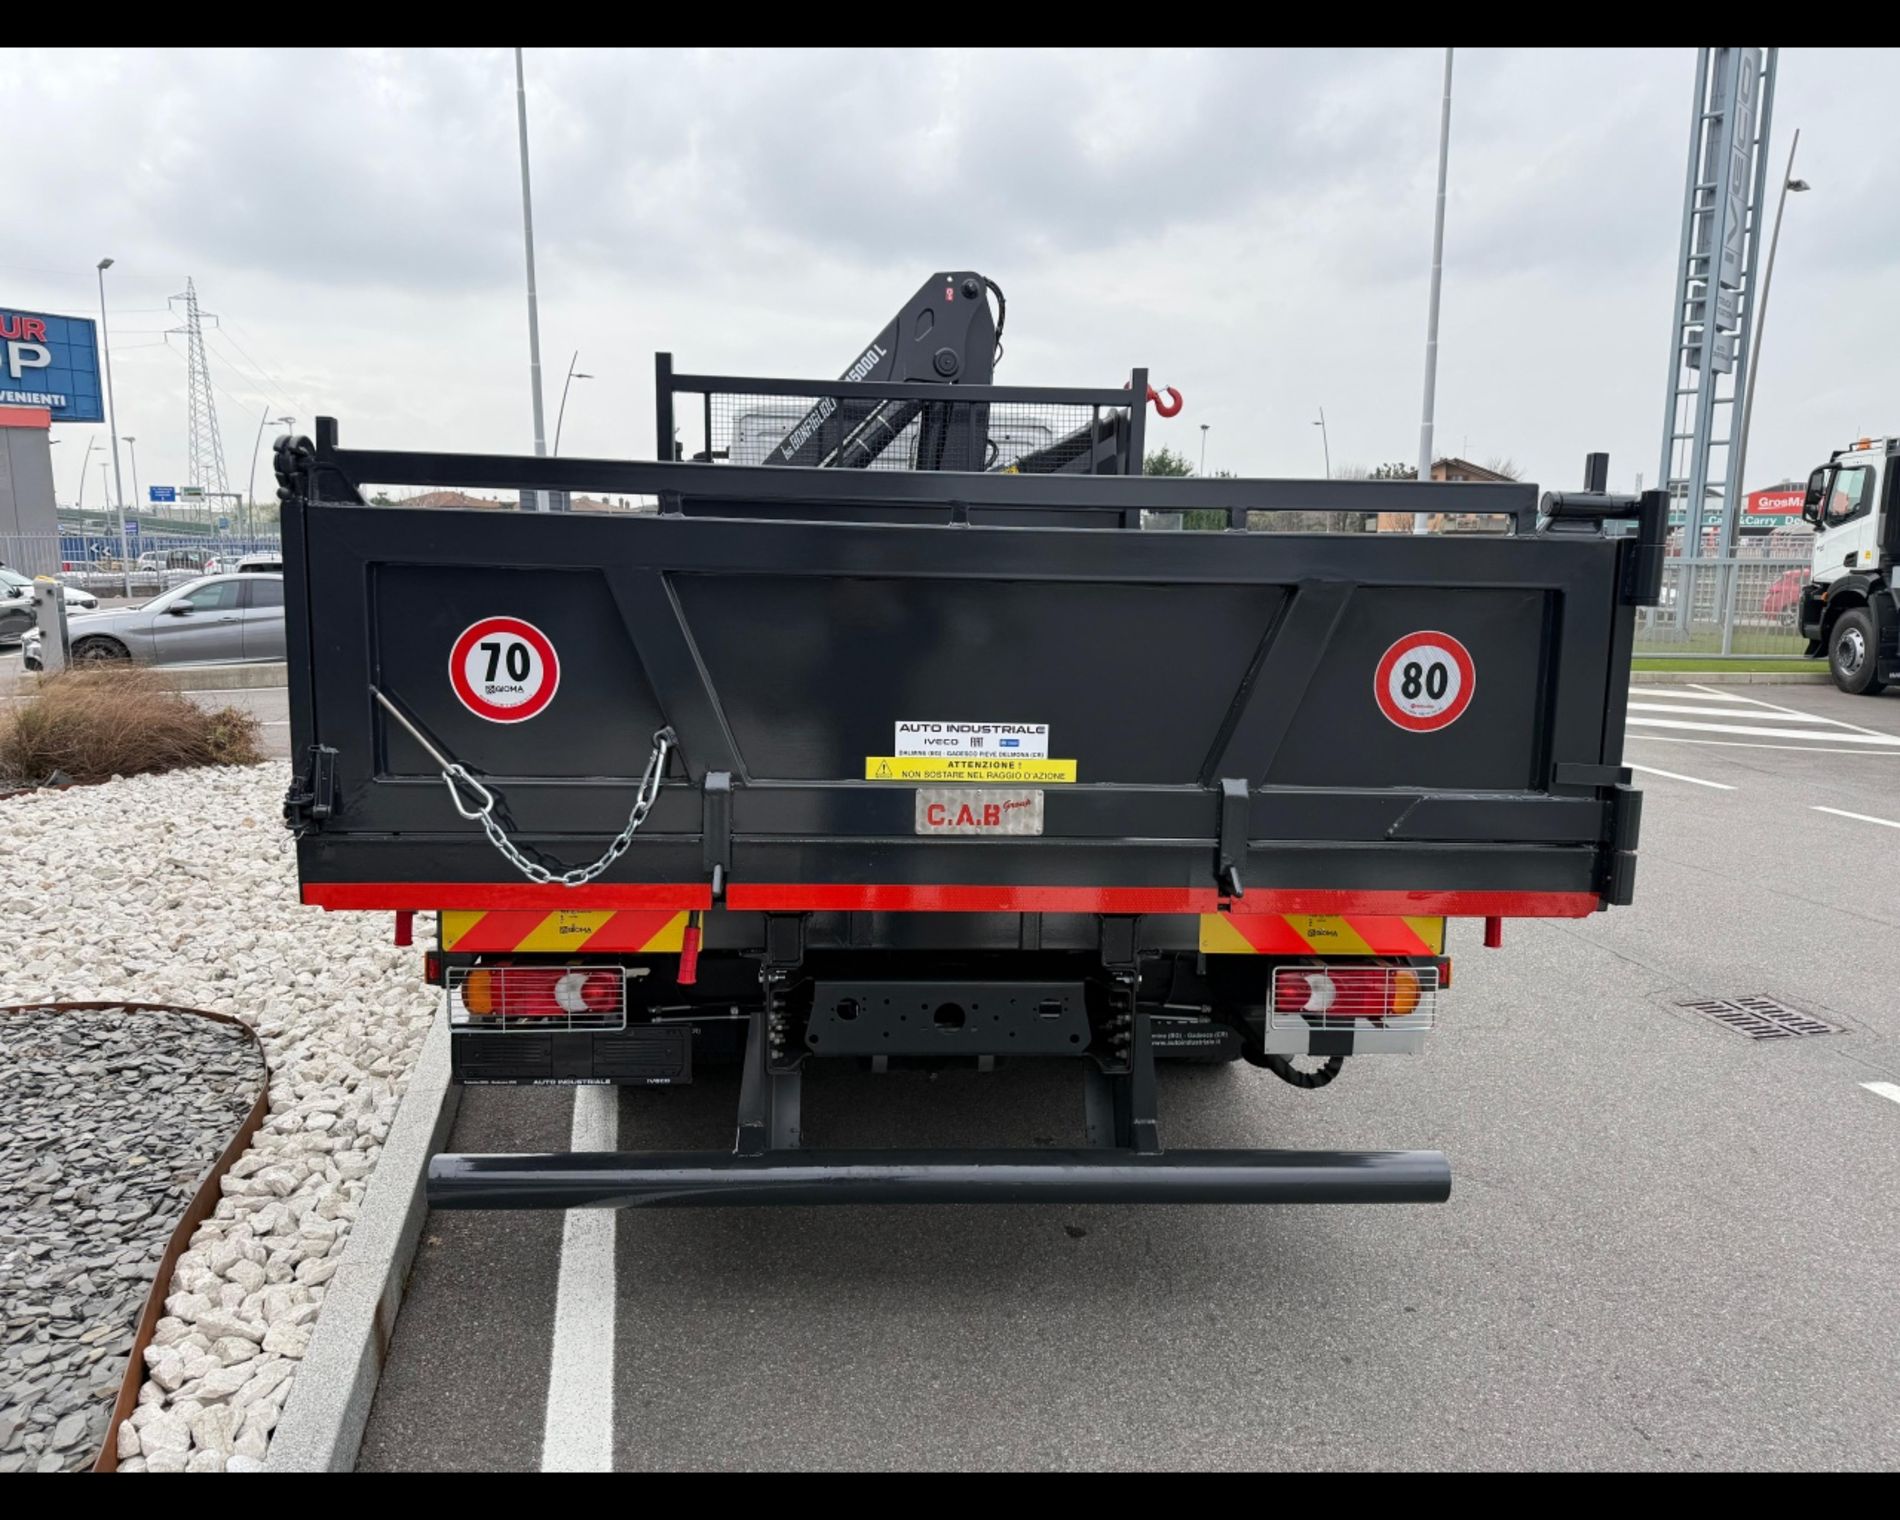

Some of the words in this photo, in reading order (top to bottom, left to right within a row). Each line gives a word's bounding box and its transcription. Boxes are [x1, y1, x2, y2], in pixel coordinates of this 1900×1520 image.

[1724, 55, 1752, 265] IVECO
[0, 341, 51, 378] P
[480, 642, 531, 682] 70
[1401, 661, 1448, 700] 80
[899, 723, 942, 733] AUTO
[946, 724, 1046, 734] INDUSTRIALE
[924, 738, 959, 746] IVECO
[970, 737, 984, 748] FIAT
[902, 770, 921, 779] NON
[924, 771, 964, 779] SOSTARE
[967, 771, 985, 779] NEL
[986, 772, 1022, 780] RAGGIO
[948, 761, 1015, 769] ATTENZIONE
[927, 803, 1001, 827] C.A.B
